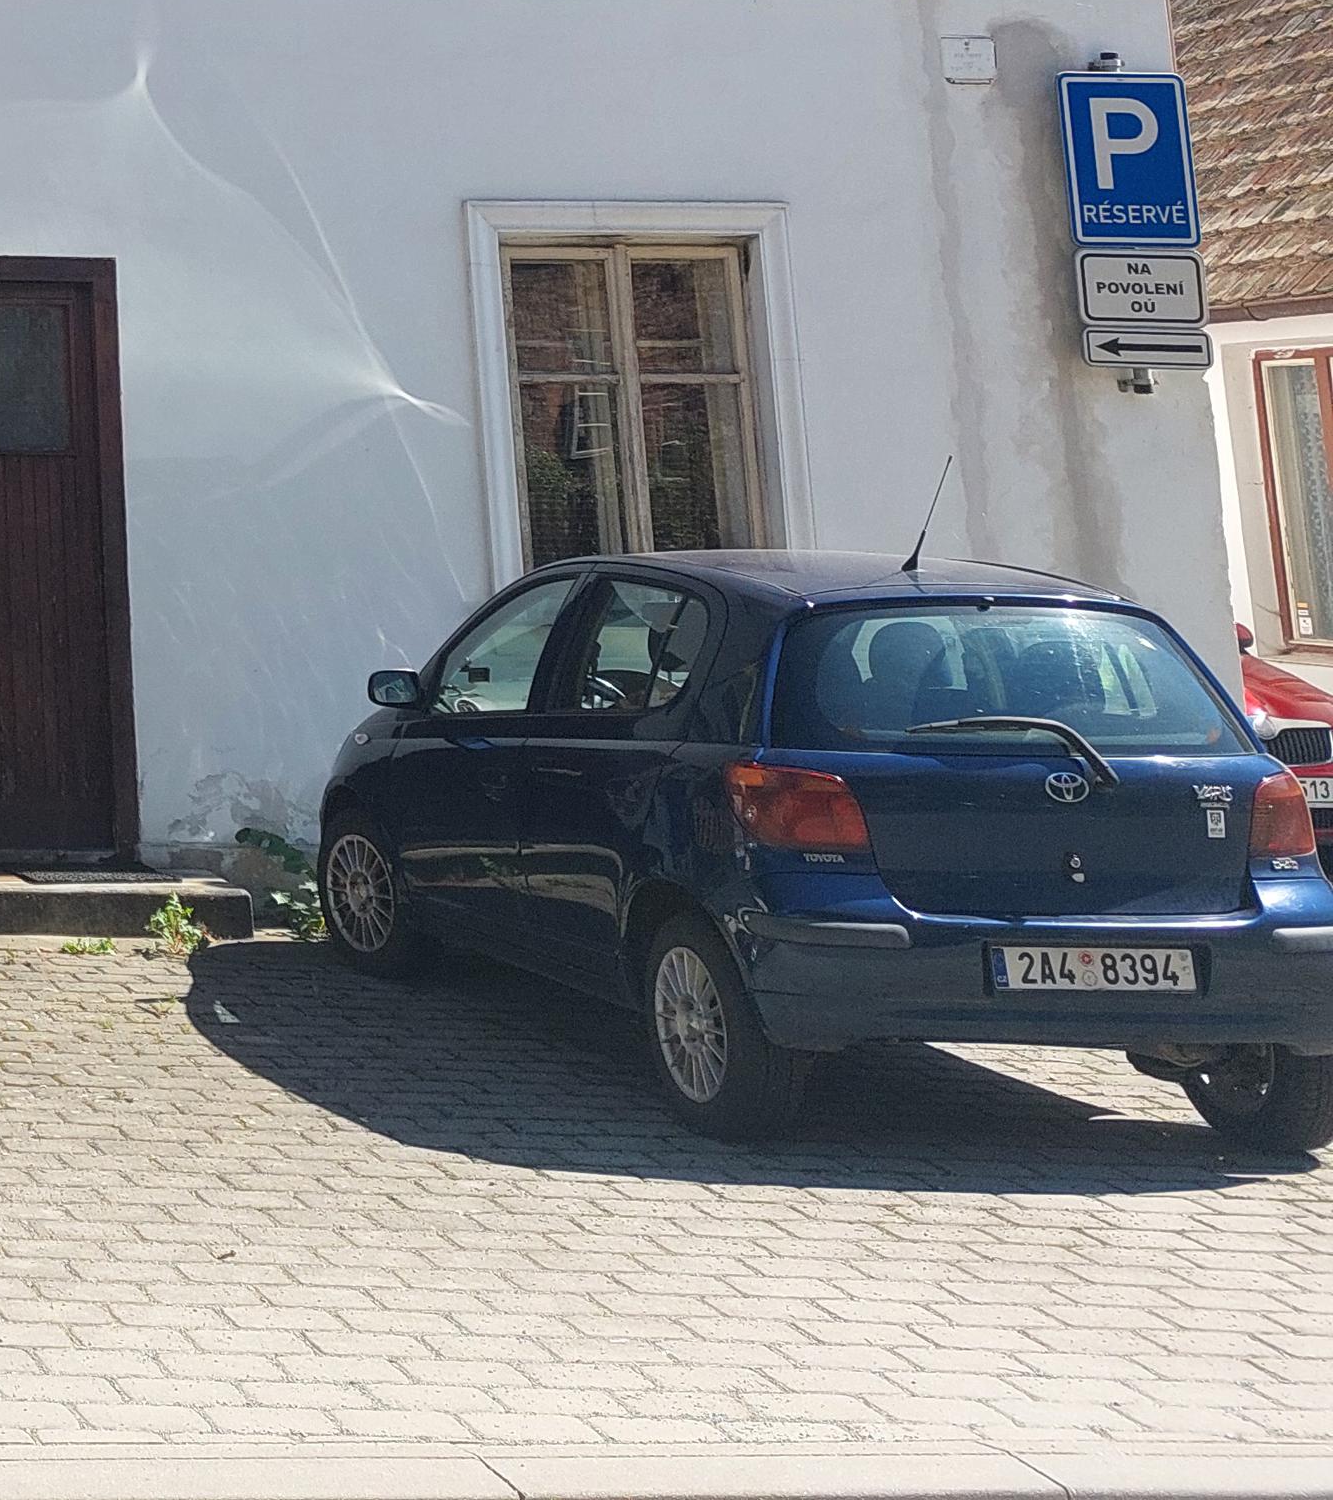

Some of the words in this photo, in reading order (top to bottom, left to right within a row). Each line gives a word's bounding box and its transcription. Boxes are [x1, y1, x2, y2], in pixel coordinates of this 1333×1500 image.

[1089, 97, 1159, 190] P
[1083, 201, 1187, 225] RÉSERVÉ
[1127, 262, 1152, 276] NA
[1095, 279, 1185, 296] POVOLENÍ
[803, 852, 846, 864] TOYOTA
[1017, 951, 1077, 986] 2A4
[1100, 952, 1181, 987] 8394
